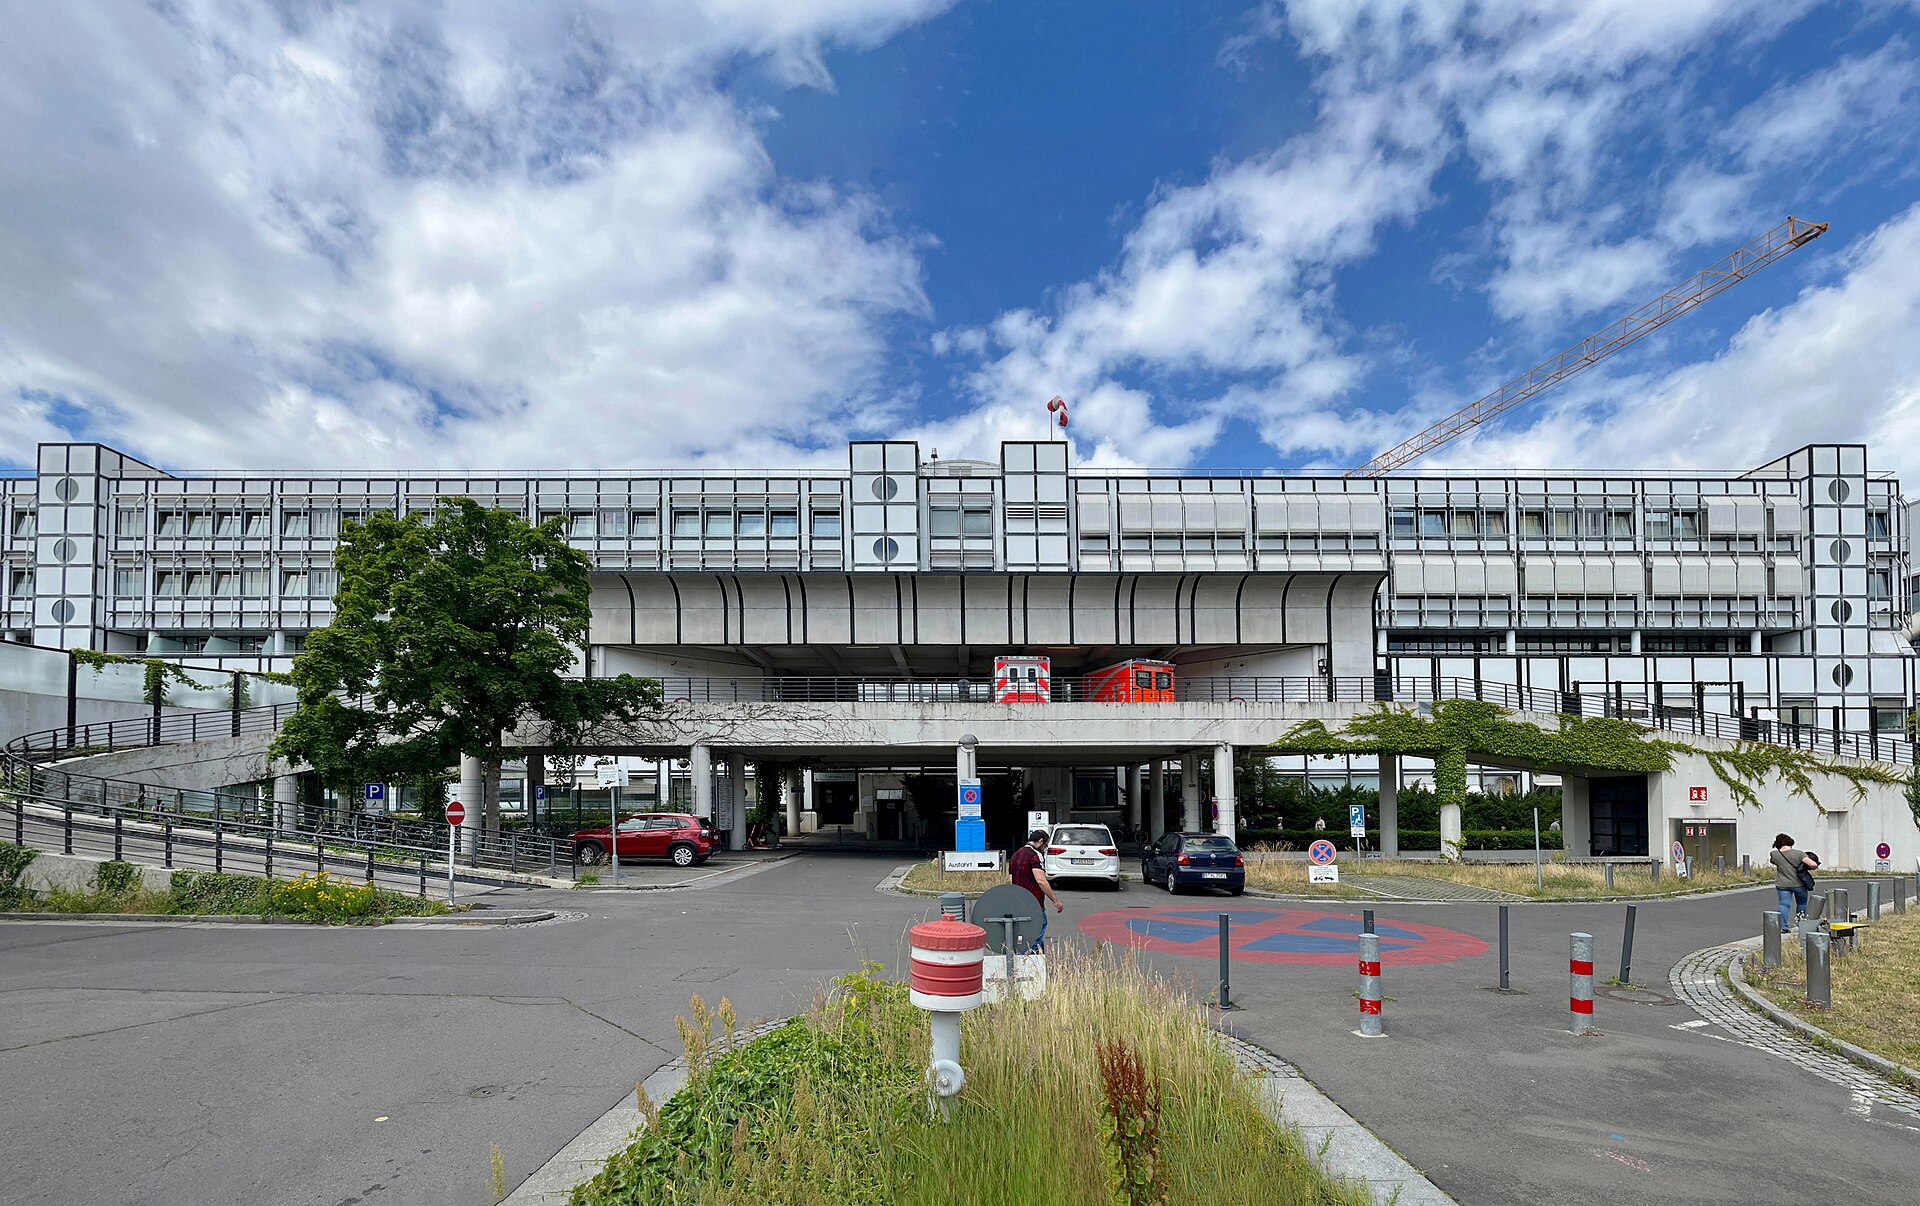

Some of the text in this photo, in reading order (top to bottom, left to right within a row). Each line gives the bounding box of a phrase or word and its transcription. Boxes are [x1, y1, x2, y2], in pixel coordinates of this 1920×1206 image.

[370, 785, 380, 798] P
[537, 787, 544, 798] P
[1352, 807, 1359, 816] P
